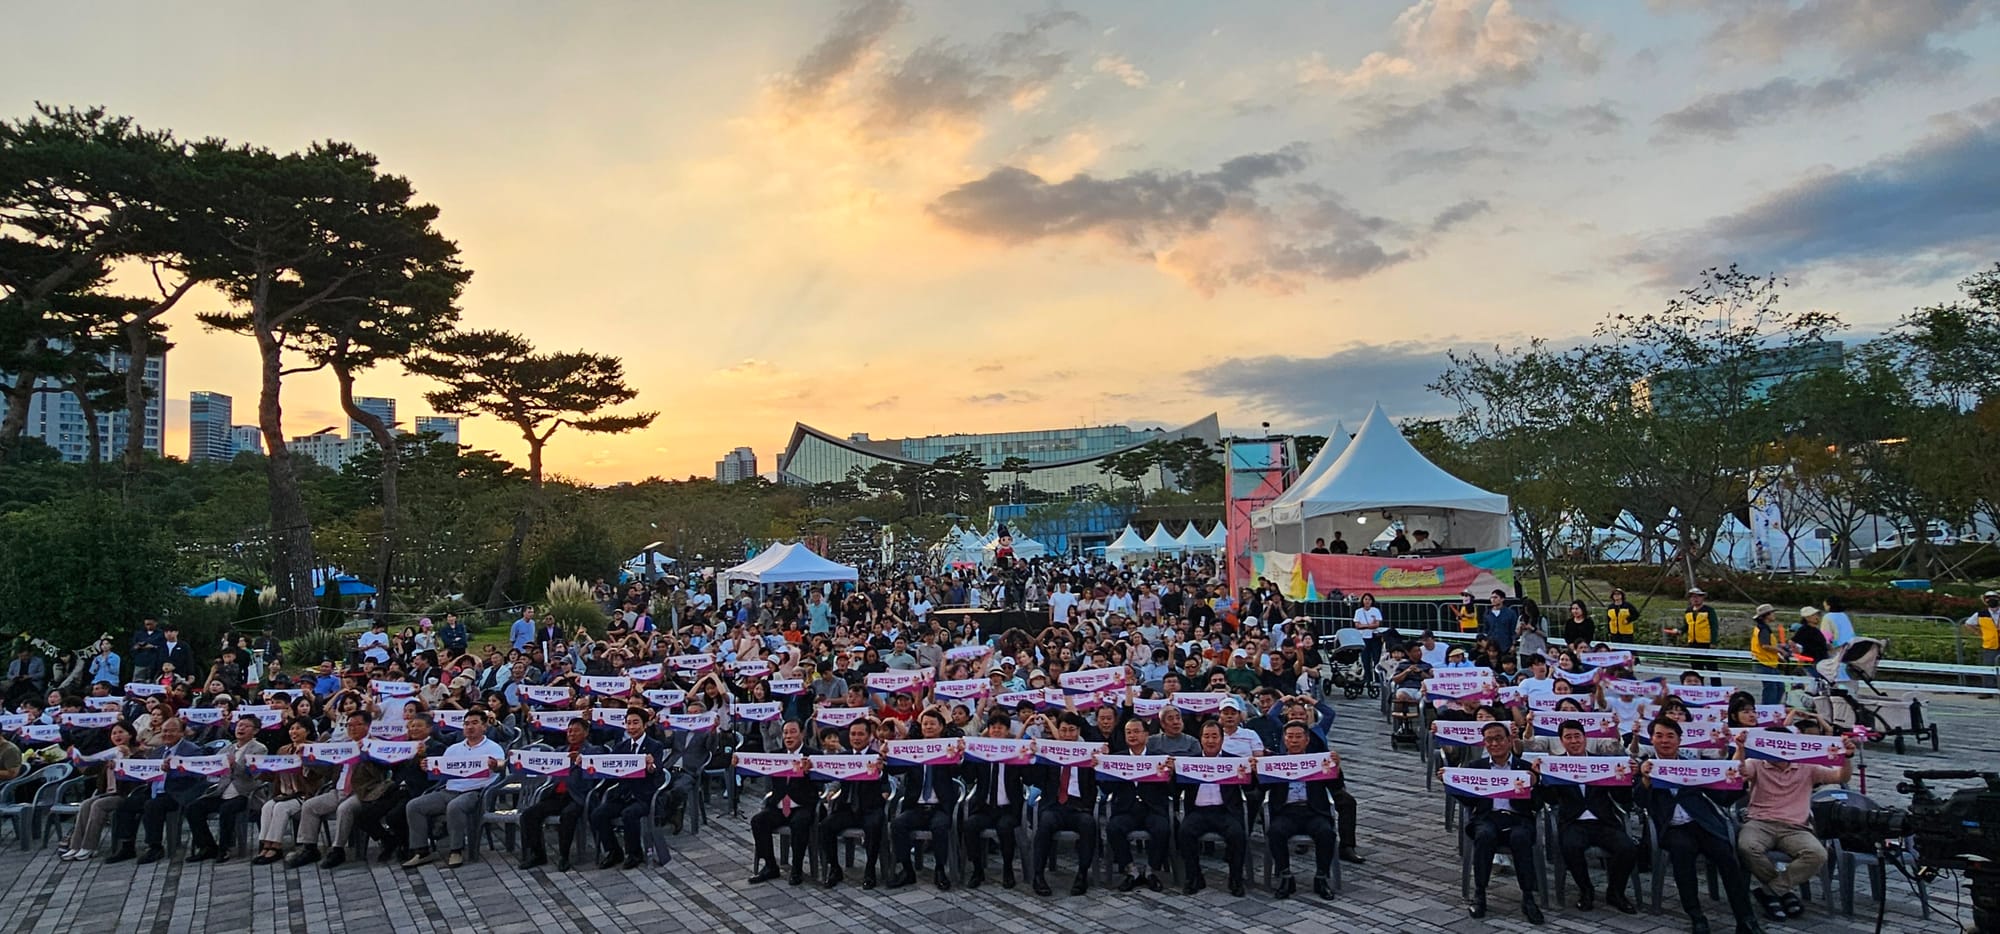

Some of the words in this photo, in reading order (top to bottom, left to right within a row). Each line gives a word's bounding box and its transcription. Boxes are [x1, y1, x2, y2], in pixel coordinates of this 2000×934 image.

[1432, 683, 1461, 691] 품격있는
[1462, 682, 1477, 690] 한우
[1443, 727, 1475, 736] 품격있는
[1686, 728, 1705, 737] 한우
[893, 746, 924, 755] 품격있는
[926, 744, 942, 753] 한우
[968, 743, 998, 753] 품격있는
[1755, 738, 1797, 750] 품격있는
[1801, 742, 1822, 752] 한우
[1040, 746, 1070, 756] 품격있는
[1072, 748, 1087, 756] 한우
[446, 761, 467, 770] 바르게
[468, 760, 482, 768] 키워
[528, 758, 548, 766] 바르게
[602, 760, 623, 768] 바르게
[624, 760, 638, 768] 키워
[744, 758, 772, 766] 품격있는
[816, 761, 846, 769] 품격있는
[1102, 761, 1134, 771] 품격있는
[1136, 762, 1152, 771] 한우
[1265, 762, 1298, 772] 품격있는
[1300, 760, 1317, 770] 한우
[1182, 764, 1215, 773] 품격있는
[1217, 764, 1233, 773] 한우
[1549, 763, 1588, 773] 품격있는
[1590, 764, 1610, 773] 한우
[1658, 766, 1698, 777] 품격있는
[1701, 768, 1720, 777] 한우
[1452, 775, 1488, 786] 품격있는
[1491, 777, 1509, 786] 한우
